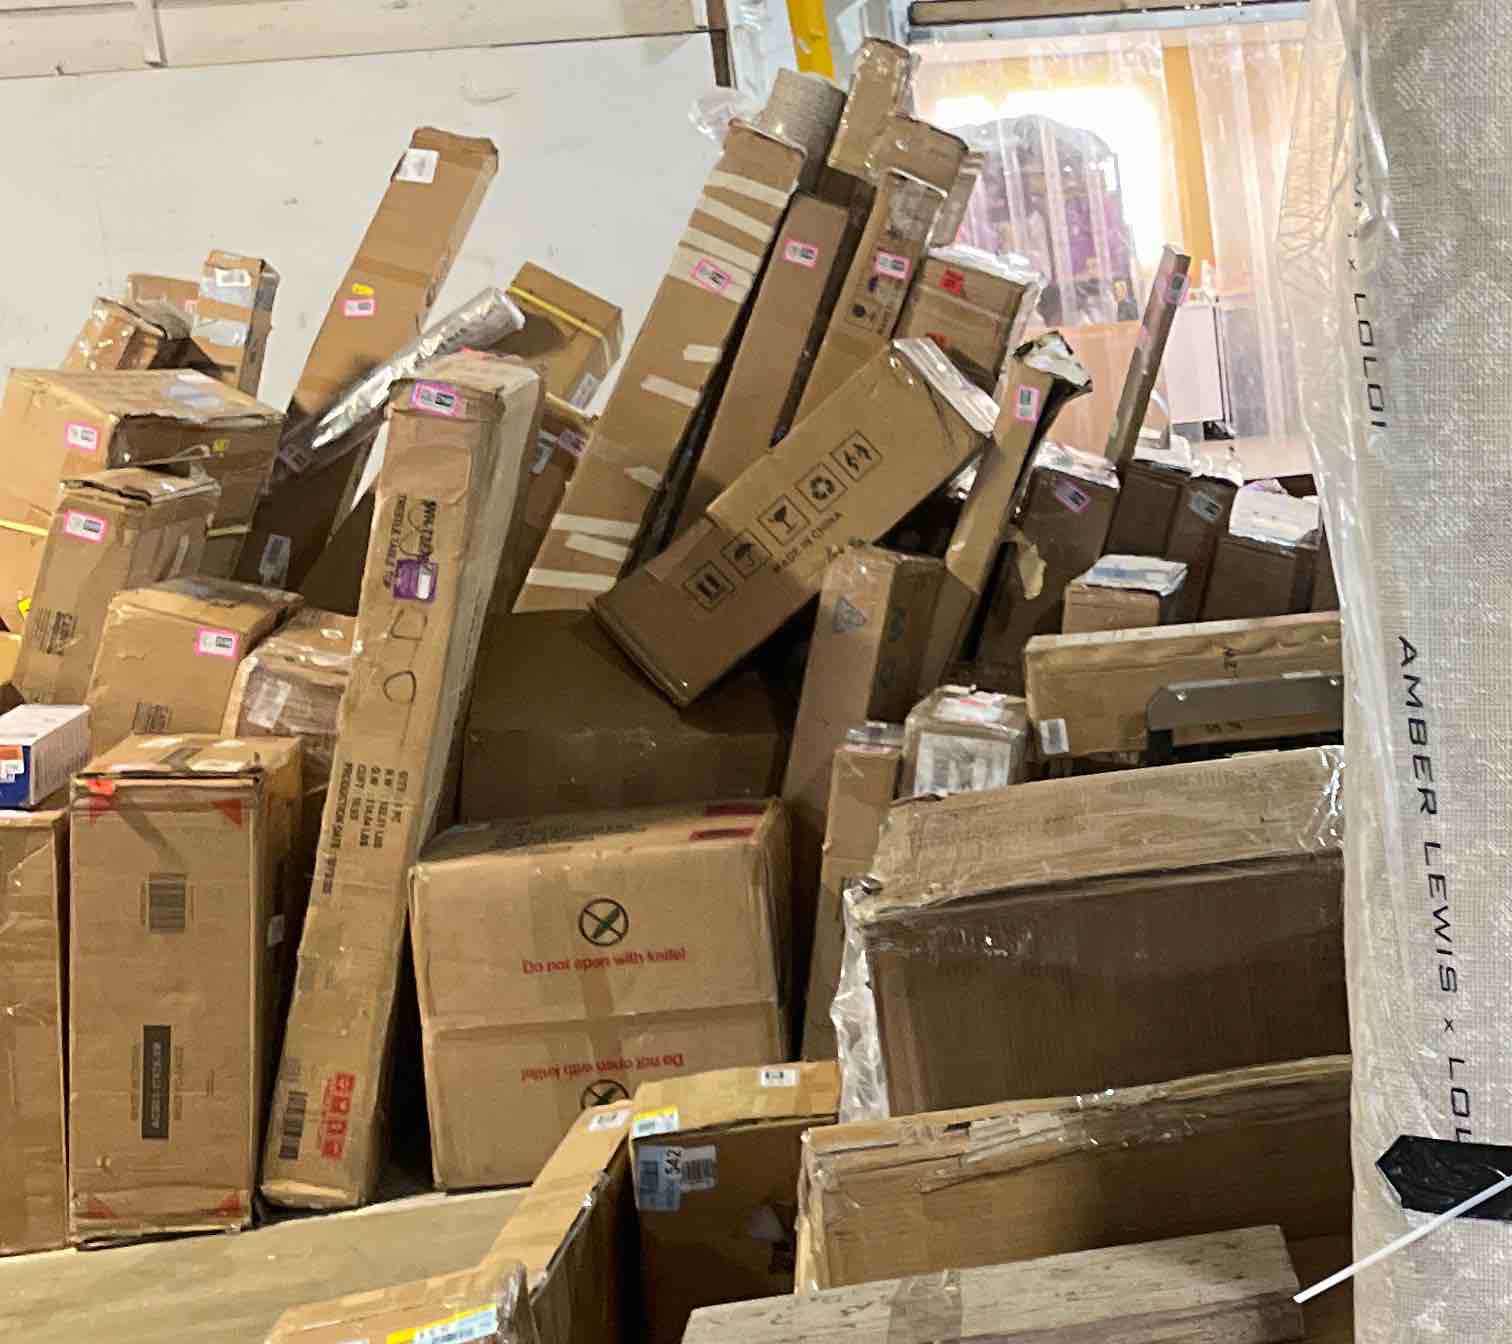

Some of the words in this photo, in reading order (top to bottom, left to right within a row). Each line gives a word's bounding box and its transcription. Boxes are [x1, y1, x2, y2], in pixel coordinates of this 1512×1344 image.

[1353, 292, 1387, 428] LOLOI
[1397, 635, 1440, 816] AMBER
[1423, 841, 1460, 994] LEWIS
[1447, 1056, 1474, 1143] LOL
[522, 959, 544, 974] Do
[547, 957, 571, 972] not
[574, 956, 610, 974] open
[613, 950, 643, 966] with
[595, 1058, 634, 1074] open
[636, 1055, 660, 1070] not
[663, 1052, 684, 1067] Do
[562, 1062, 593, 1079] with
